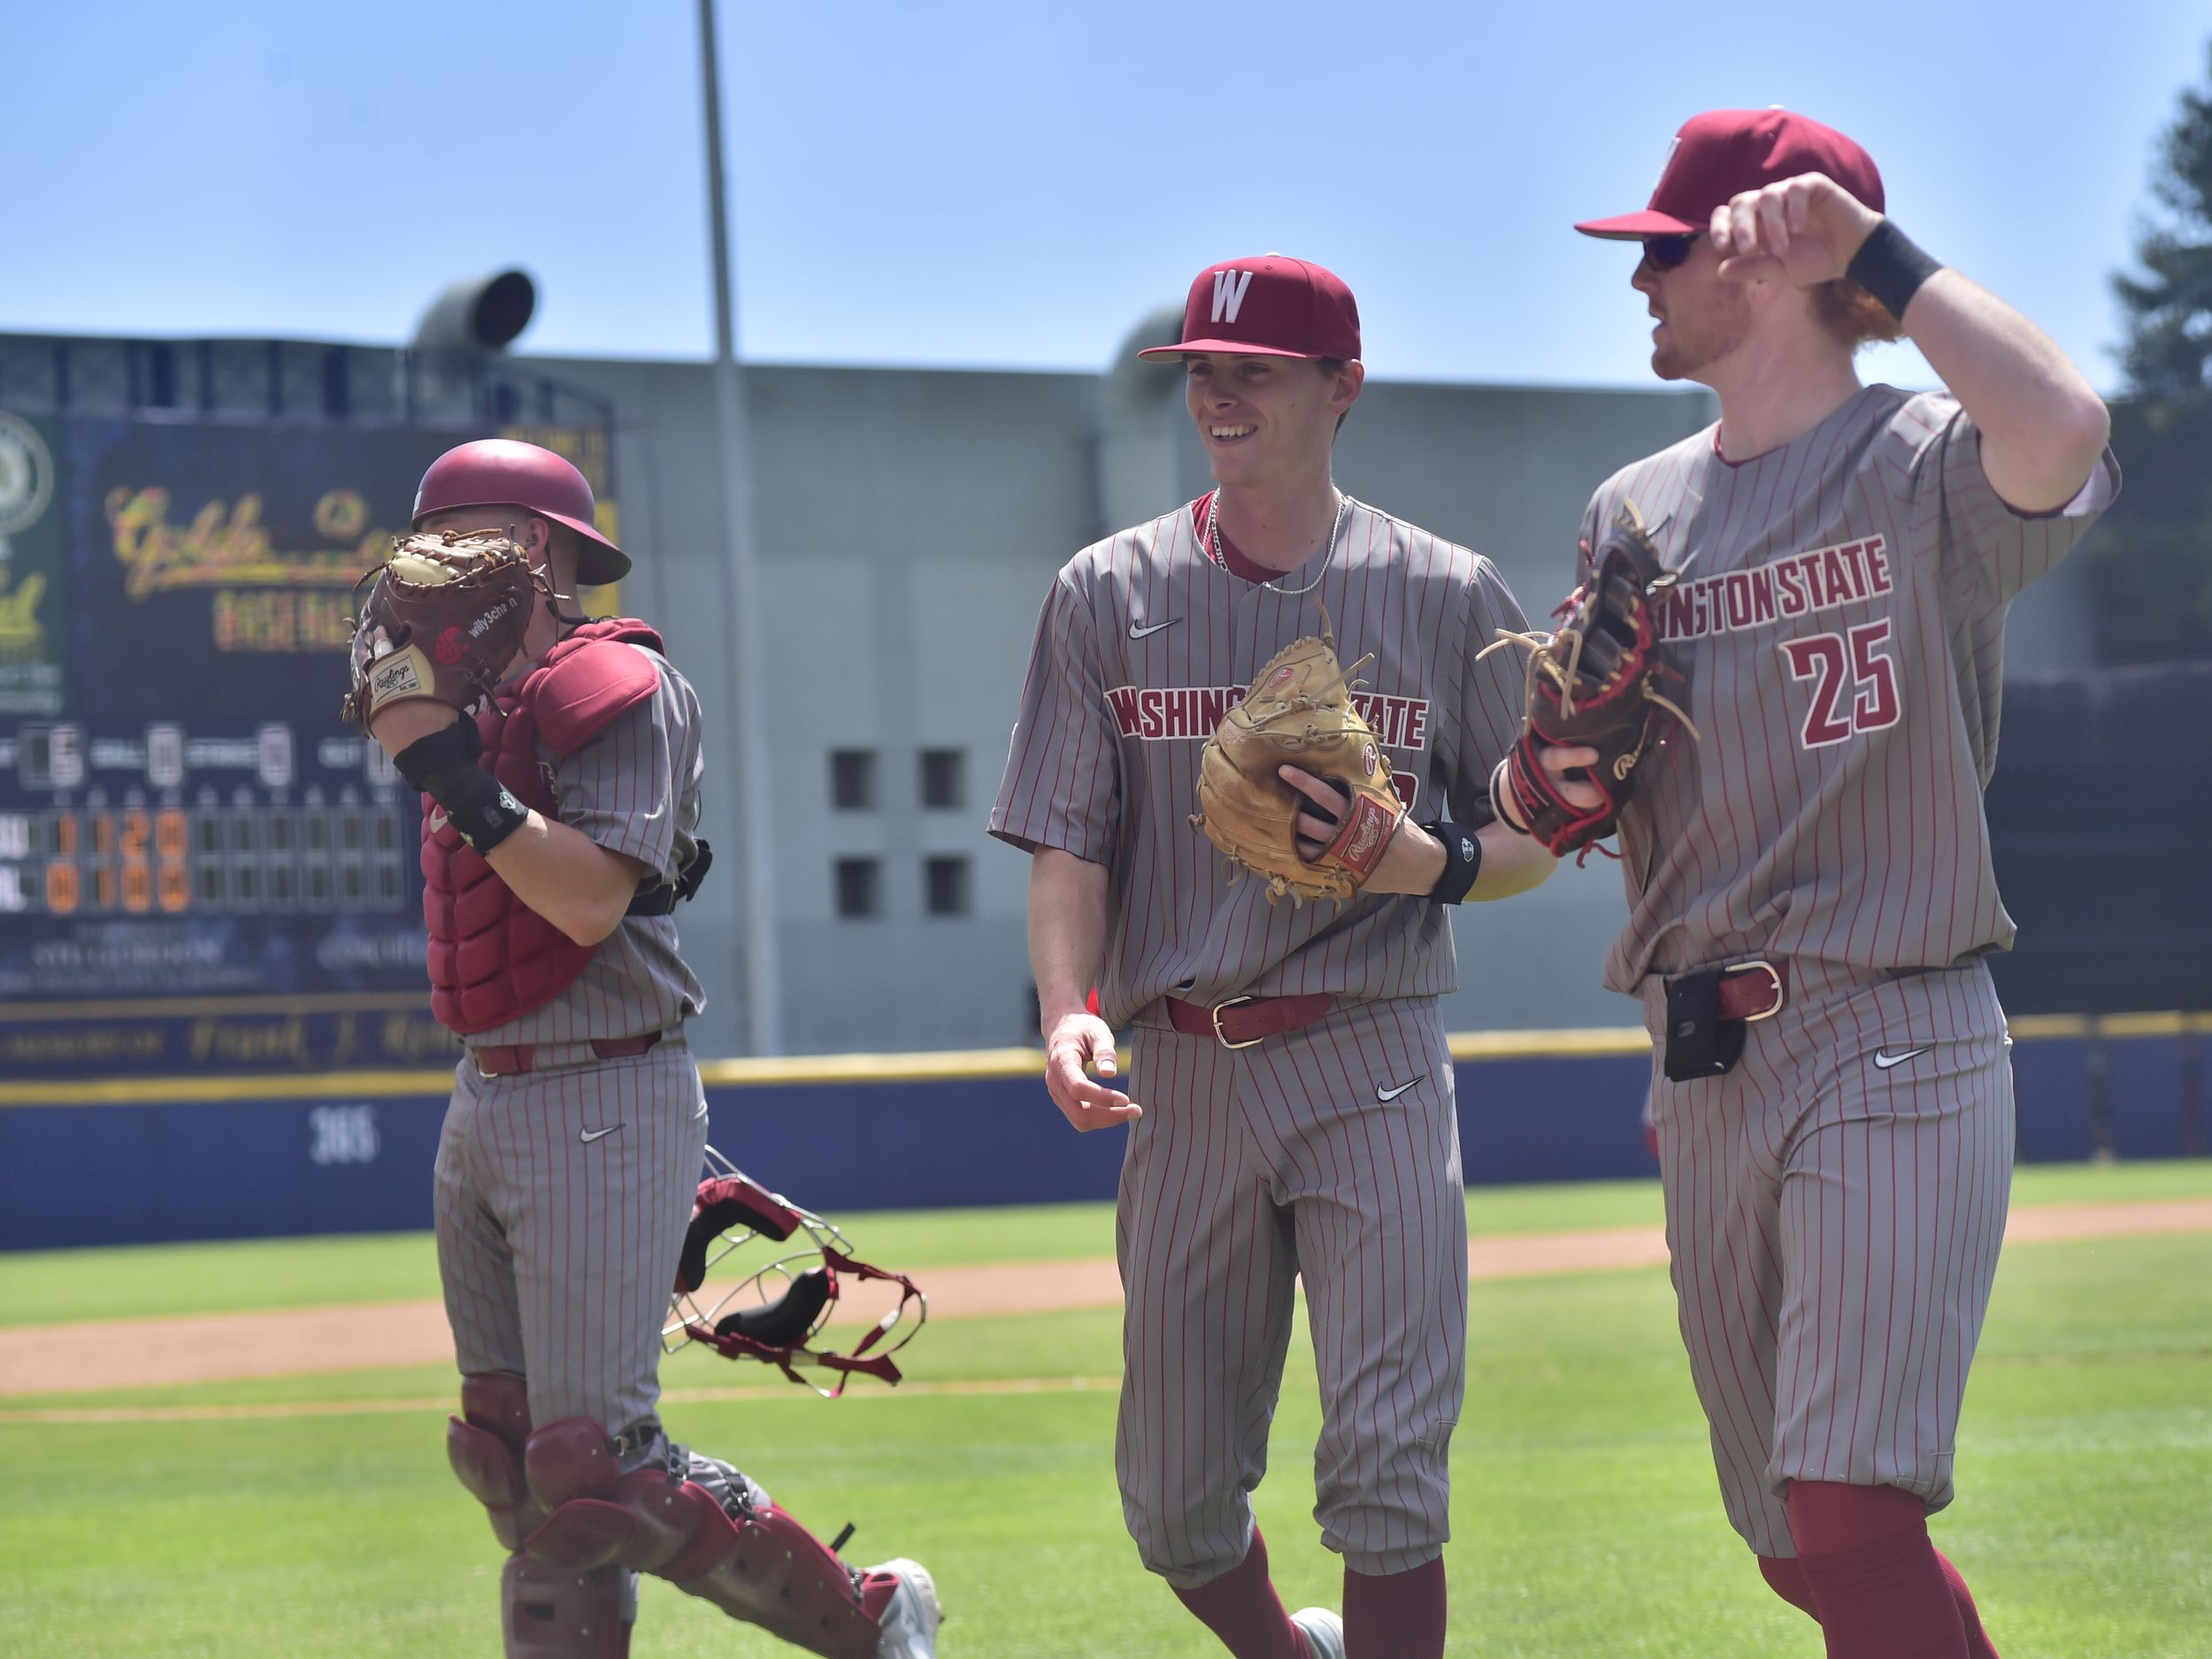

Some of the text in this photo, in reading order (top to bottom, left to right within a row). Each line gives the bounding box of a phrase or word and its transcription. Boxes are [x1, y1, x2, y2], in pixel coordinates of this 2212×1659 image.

[1210, 269, 1253, 324] W
[1772, 533, 1893, 618] STATE
[1778, 617, 1901, 750] 25
[1348, 690, 1430, 751] TATE
[1348, 806, 1380, 862] Rawlings
